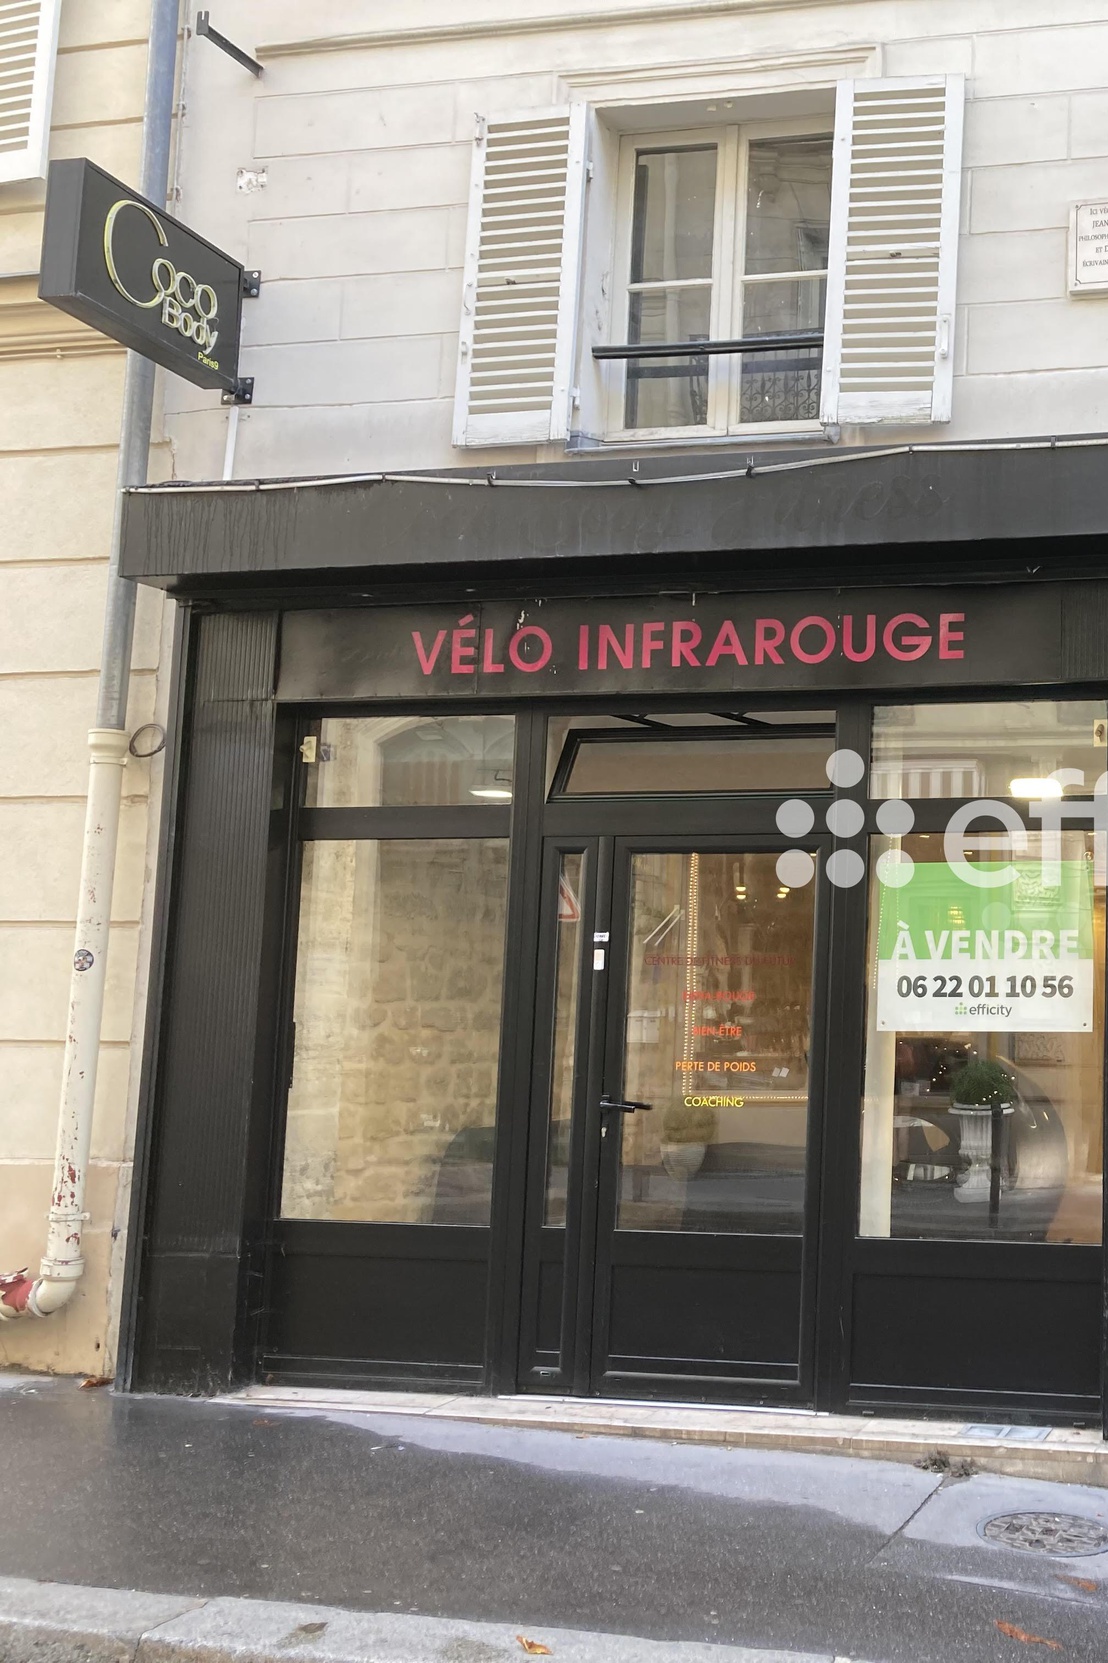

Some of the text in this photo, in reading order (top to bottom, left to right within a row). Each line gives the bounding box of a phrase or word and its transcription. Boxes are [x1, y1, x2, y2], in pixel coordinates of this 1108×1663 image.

[104, 200, 217, 320] Coco
[162, 296, 219, 355] Body
[411, 612, 966, 676] VÉLO INFRAROUGE
[890, 920, 1079, 960] À VENDRE
[644, 955, 683, 966] CENTRE
[897, 975, 1074, 998] 06 22 01 10 56
[969, 1003, 1013, 1017] efficity
[693, 1023, 742, 1036] BIEN-ÊTRE
[675, 1061, 757, 1072] PERTE DE POIDS
[684, 1096, 744, 1108] COACHING
